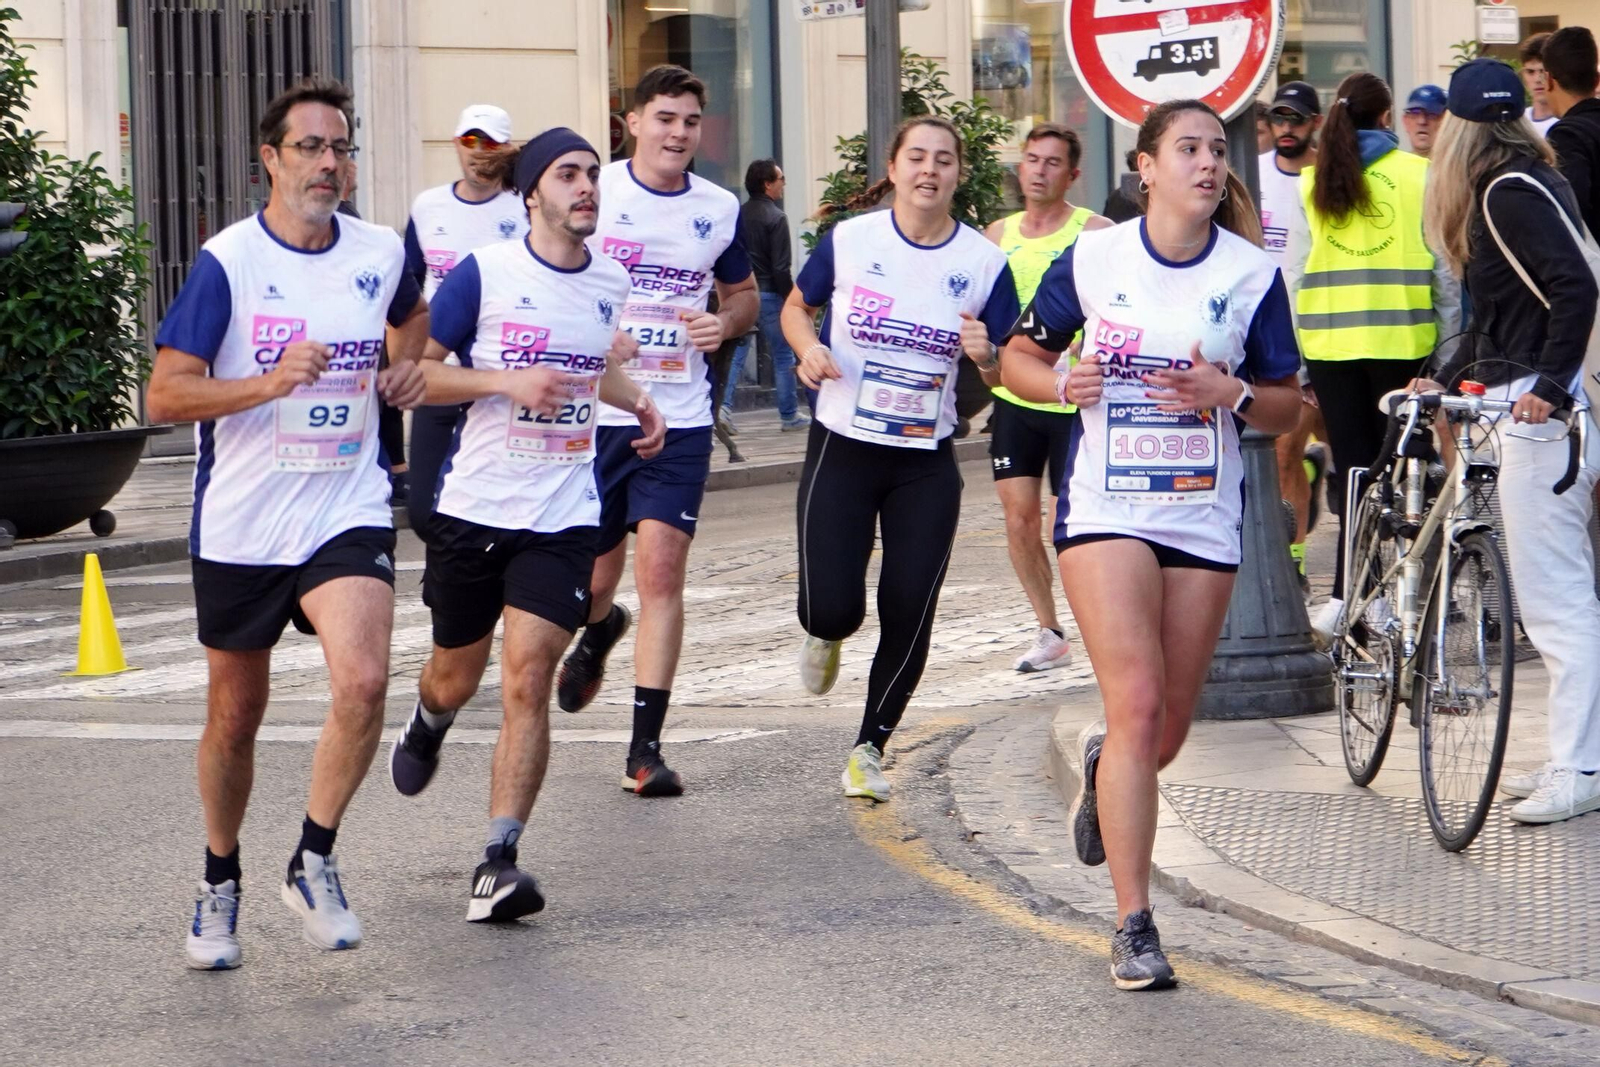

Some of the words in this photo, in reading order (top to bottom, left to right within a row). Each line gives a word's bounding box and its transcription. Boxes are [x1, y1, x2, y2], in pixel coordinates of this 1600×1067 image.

[1170, 40, 1214, 64] 3,5t
[1370, 171, 1396, 190] ACTIVA
[1326, 235, 1354, 256] CAMPUS
[1356, 235, 1395, 257] SALUDABLE
[852, 294, 891, 314] 10ª
[257, 320, 304, 345] 10ª
[505, 328, 549, 349] 10ª
[1096, 326, 1139, 350] 10ª
[874, 388, 926, 414] 951
[308, 404, 350, 428] 93
[1114, 434, 1210, 460] 1038
